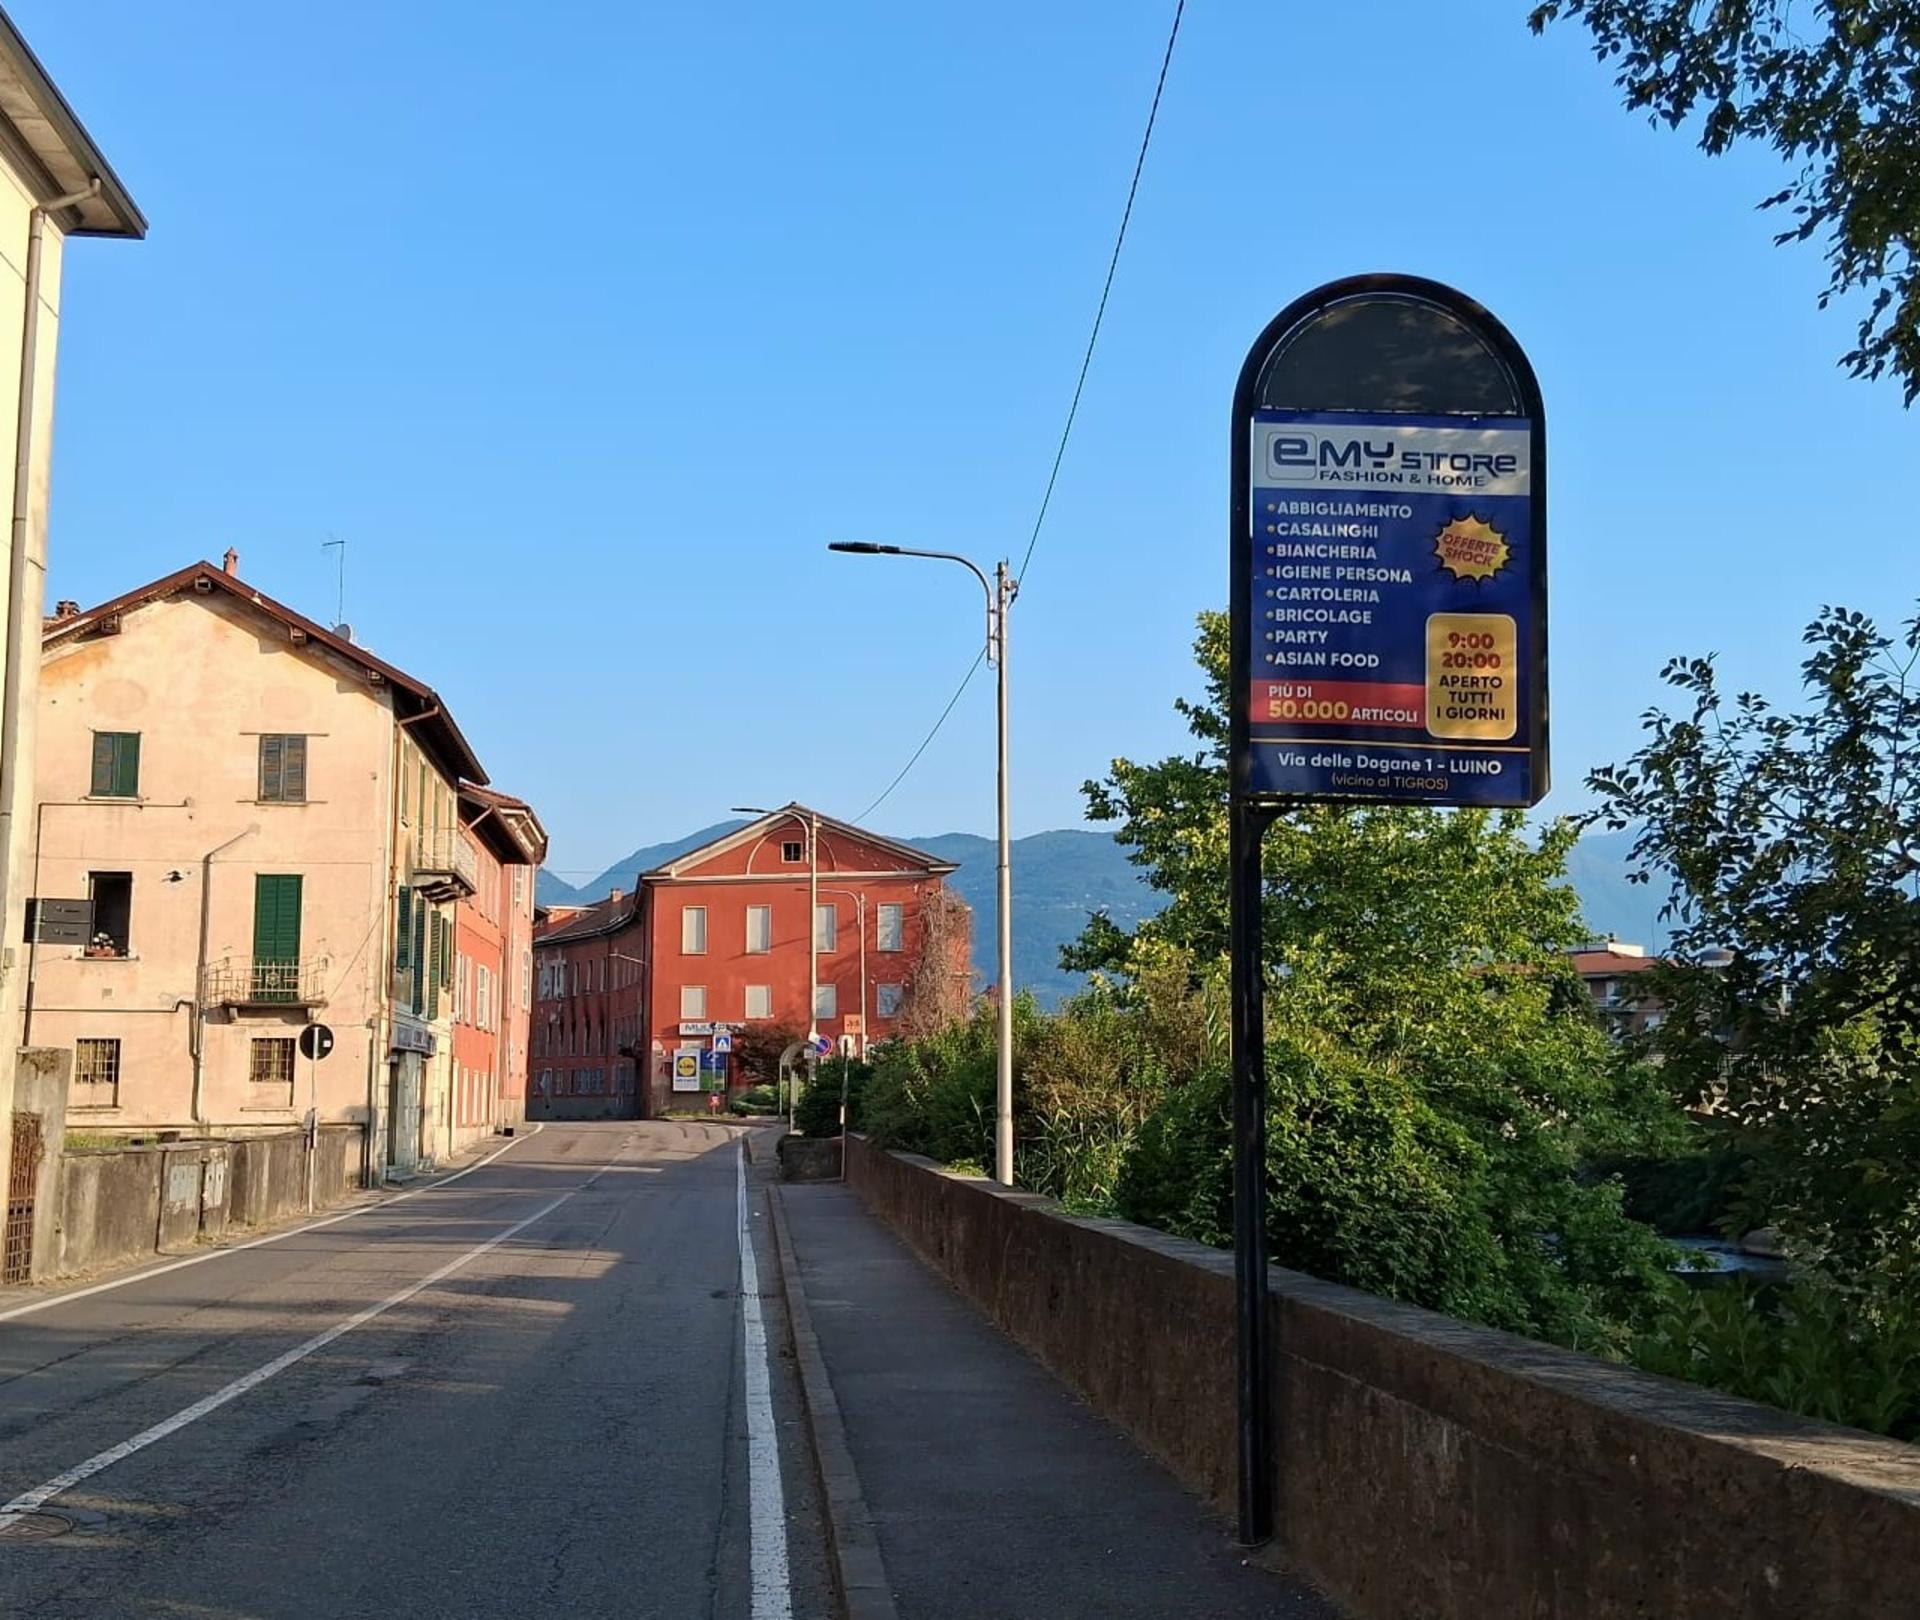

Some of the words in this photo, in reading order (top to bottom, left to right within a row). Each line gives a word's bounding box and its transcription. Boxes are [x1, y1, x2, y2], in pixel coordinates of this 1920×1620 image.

[1320, 471, 1403, 483] FASHION
[1409, 474, 1421, 483] &
[1427, 475, 1485, 486] HOME
[1277, 502, 1412, 519] ABBIGLIAMENTO
[1277, 523, 1378, 539] CASALINGHI
[1277, 544, 1377, 560] BIANCHERIA
[1442, 534, 1501, 555] OFFERTE
[1444, 547, 1495, 567] SHOCK
[1276, 566, 1331, 579] IGIENE
[1336, 568, 1412, 583] PERSONA
[1276, 588, 1380, 603] CARTOLERIA
[1275, 609, 1372, 624] BRICOLAGE
[1275, 630, 1328, 644] PARTY
[1448, 632, 1495, 649] 9:00
[1275, 652, 1325, 666] ASIAN
[1331, 653, 1380, 668] FOOD
[1442, 653, 1501, 669] 20:00
[1439, 675, 1502, 689] APERTO
[1269, 684, 1292, 698] PIÙ
[1297, 686, 1312, 698] DI
[1448, 691, 1492, 704] TUTTI
[1268, 700, 1348, 719] 50.000
[1351, 708, 1417, 723] ARTICOLI
[1446, 707, 1505, 720] GIORNI
[1278, 753, 1305, 766] Via
[1311, 753, 1351, 768] delle
[1356, 756, 1421, 773] Dogane
[1425, 758, 1432, 771] 1
[1450, 760, 1502, 775] LUINO
[1331, 775, 1374, 787] (vicino
[1378, 776, 1389, 787] al
[1393, 777, 1449, 791] TIGROS)
